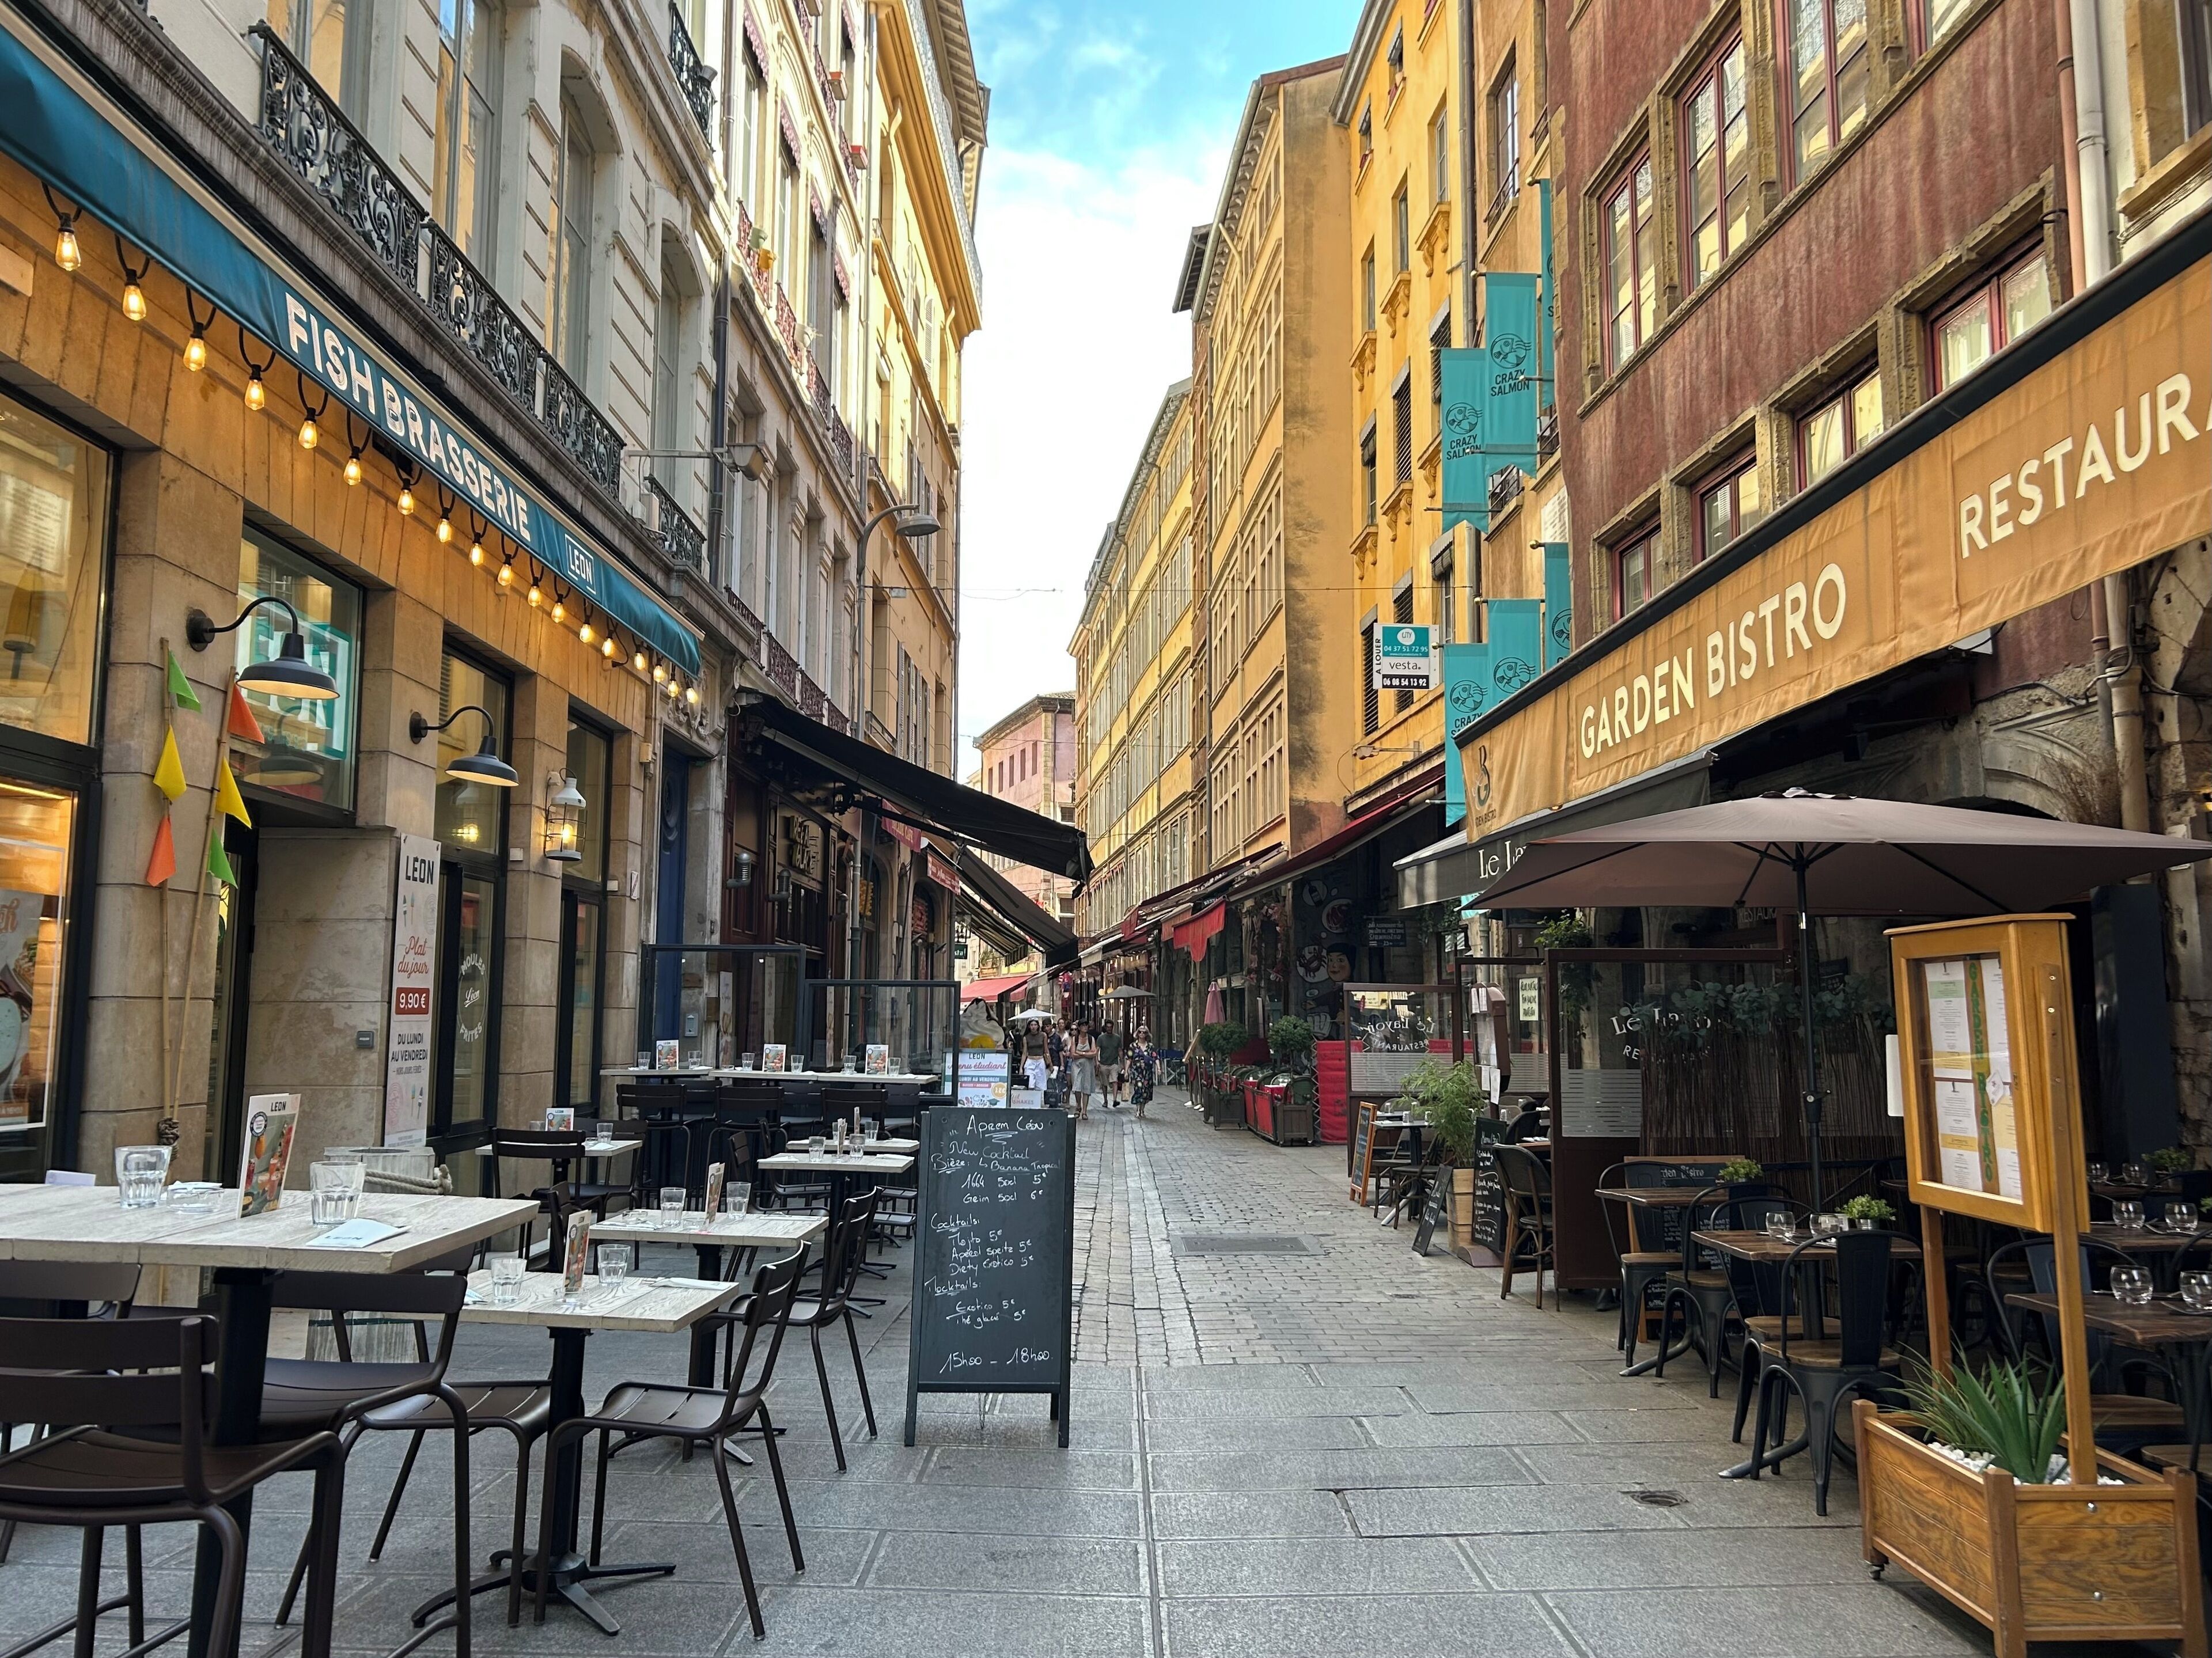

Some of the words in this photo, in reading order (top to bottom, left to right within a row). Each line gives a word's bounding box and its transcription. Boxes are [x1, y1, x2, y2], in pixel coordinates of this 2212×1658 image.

[1495, 369, 1526, 385] CRAZY
[1490, 381, 1530, 396] SALMON
[286, 292, 376, 415] FISH
[381, 377, 532, 542] BRASSERIE
[1450, 434, 1478, 449] CRAZY
[1960, 373, 2212, 559] RESTAUR
[1581, 647, 1695, 759] GARDEN
[1707, 563, 1846, 698] BISTRO
[1392, 678, 1400, 686] 08
[1479, 849, 1499, 879] Le
[405, 935, 427, 956] Plat
[407, 958, 429, 979] jour
[461, 953, 486, 976] MOULES
[400, 993, 419, 1010] 9,90
[397, 1034, 406, 1045] DU
[407, 1033, 423, 1044] LUNDI
[460, 1022, 483, 1042] FRITES
[391, 1050, 399, 1062] AU
[401, 1049, 428, 1061] VENDREDI
[974, 1061, 1006, 1069] étudiant
[949, 1141, 979, 1155] New
[983, 1146, 1030, 1159] Cocktail
[990, 1160, 1030, 1171] Banana
[1030, 1159, 1060, 1173] Tropical
[961, 1172, 985, 1189] 1664
[940, 1351, 982, 1374] 15h00
[1006, 1347, 1050, 1365] 18h00
